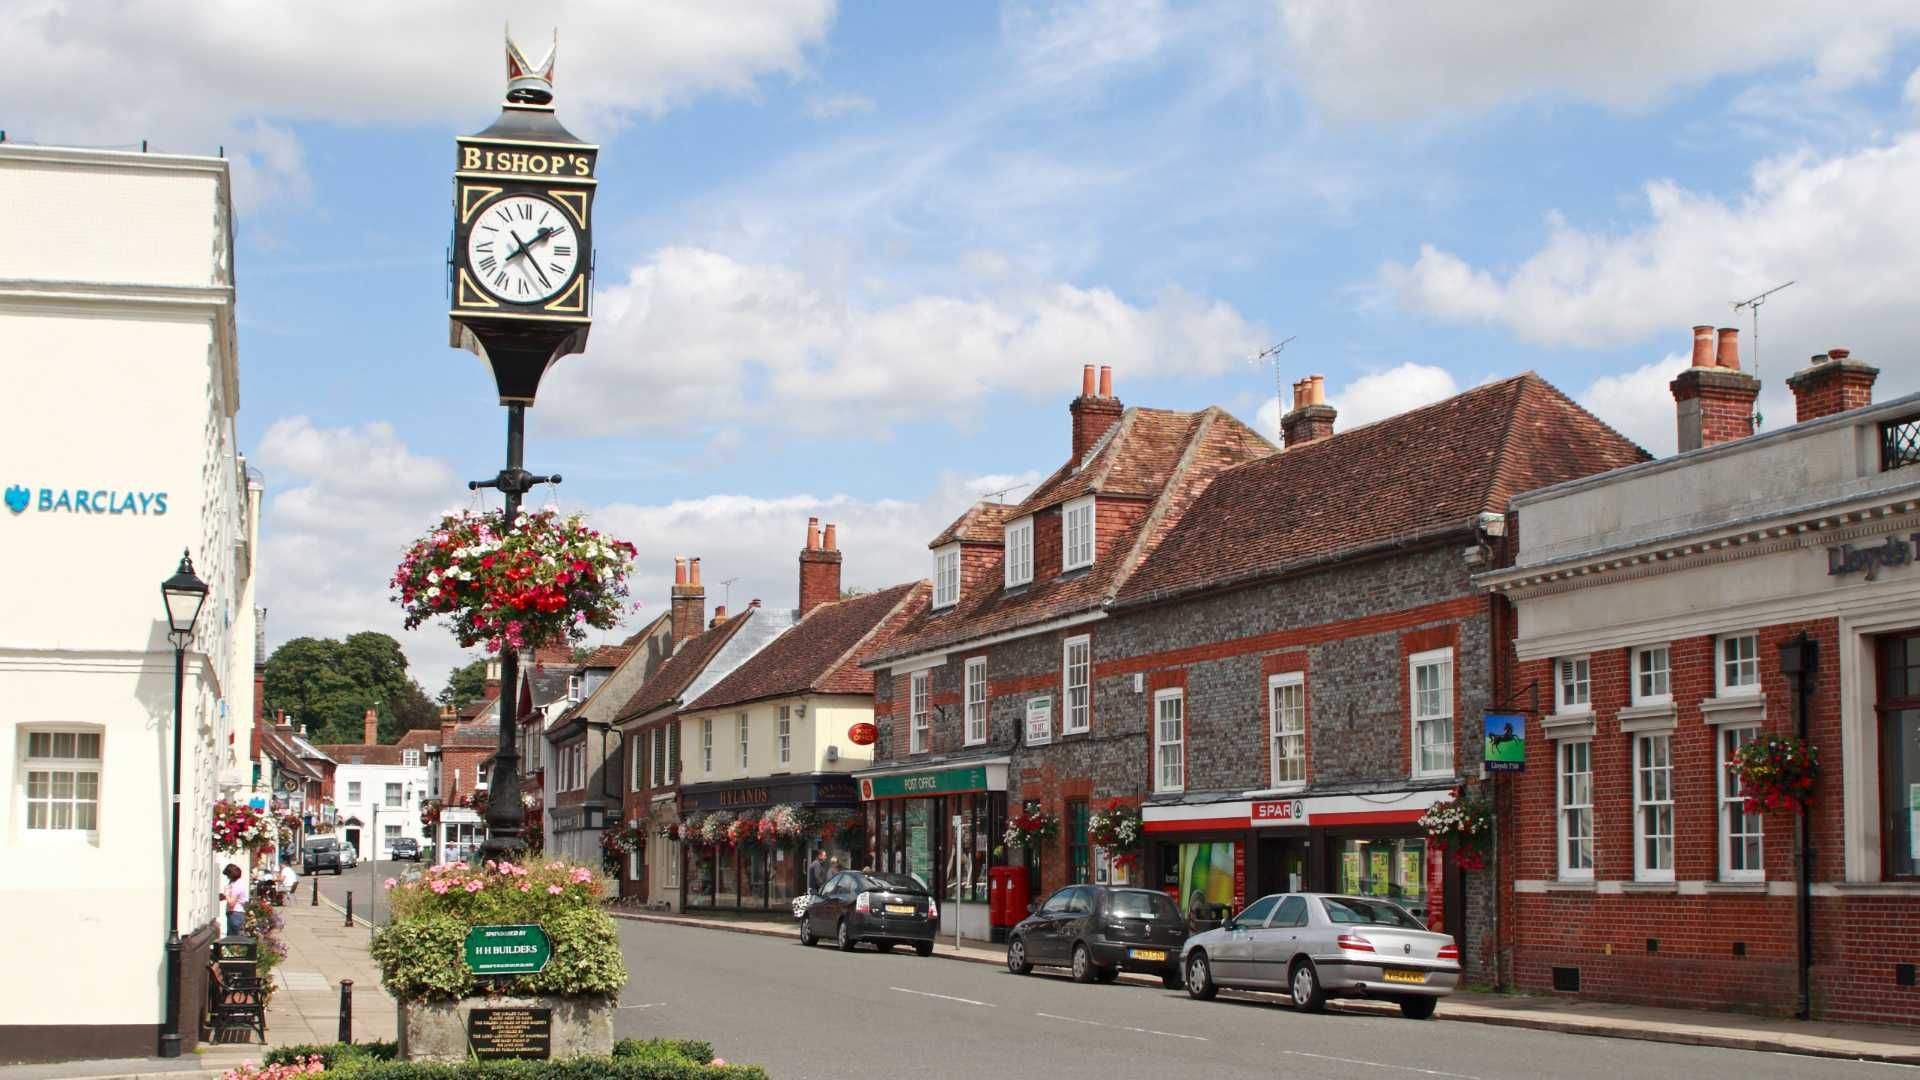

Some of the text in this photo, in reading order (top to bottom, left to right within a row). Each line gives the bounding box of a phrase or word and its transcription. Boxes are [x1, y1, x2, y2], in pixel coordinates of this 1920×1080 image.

[463, 147, 590, 176] BISHOP'S
[38, 487, 168, 517] BARCLAYS
[1826, 534, 1912, 582] Lloyds
[904, 776, 937, 791] POST OFFICE
[720, 787, 768, 805] HYLANDS
[1258, 804, 1292, 817] SPAR
[475, 945, 538, 955] H H BUILDERS
